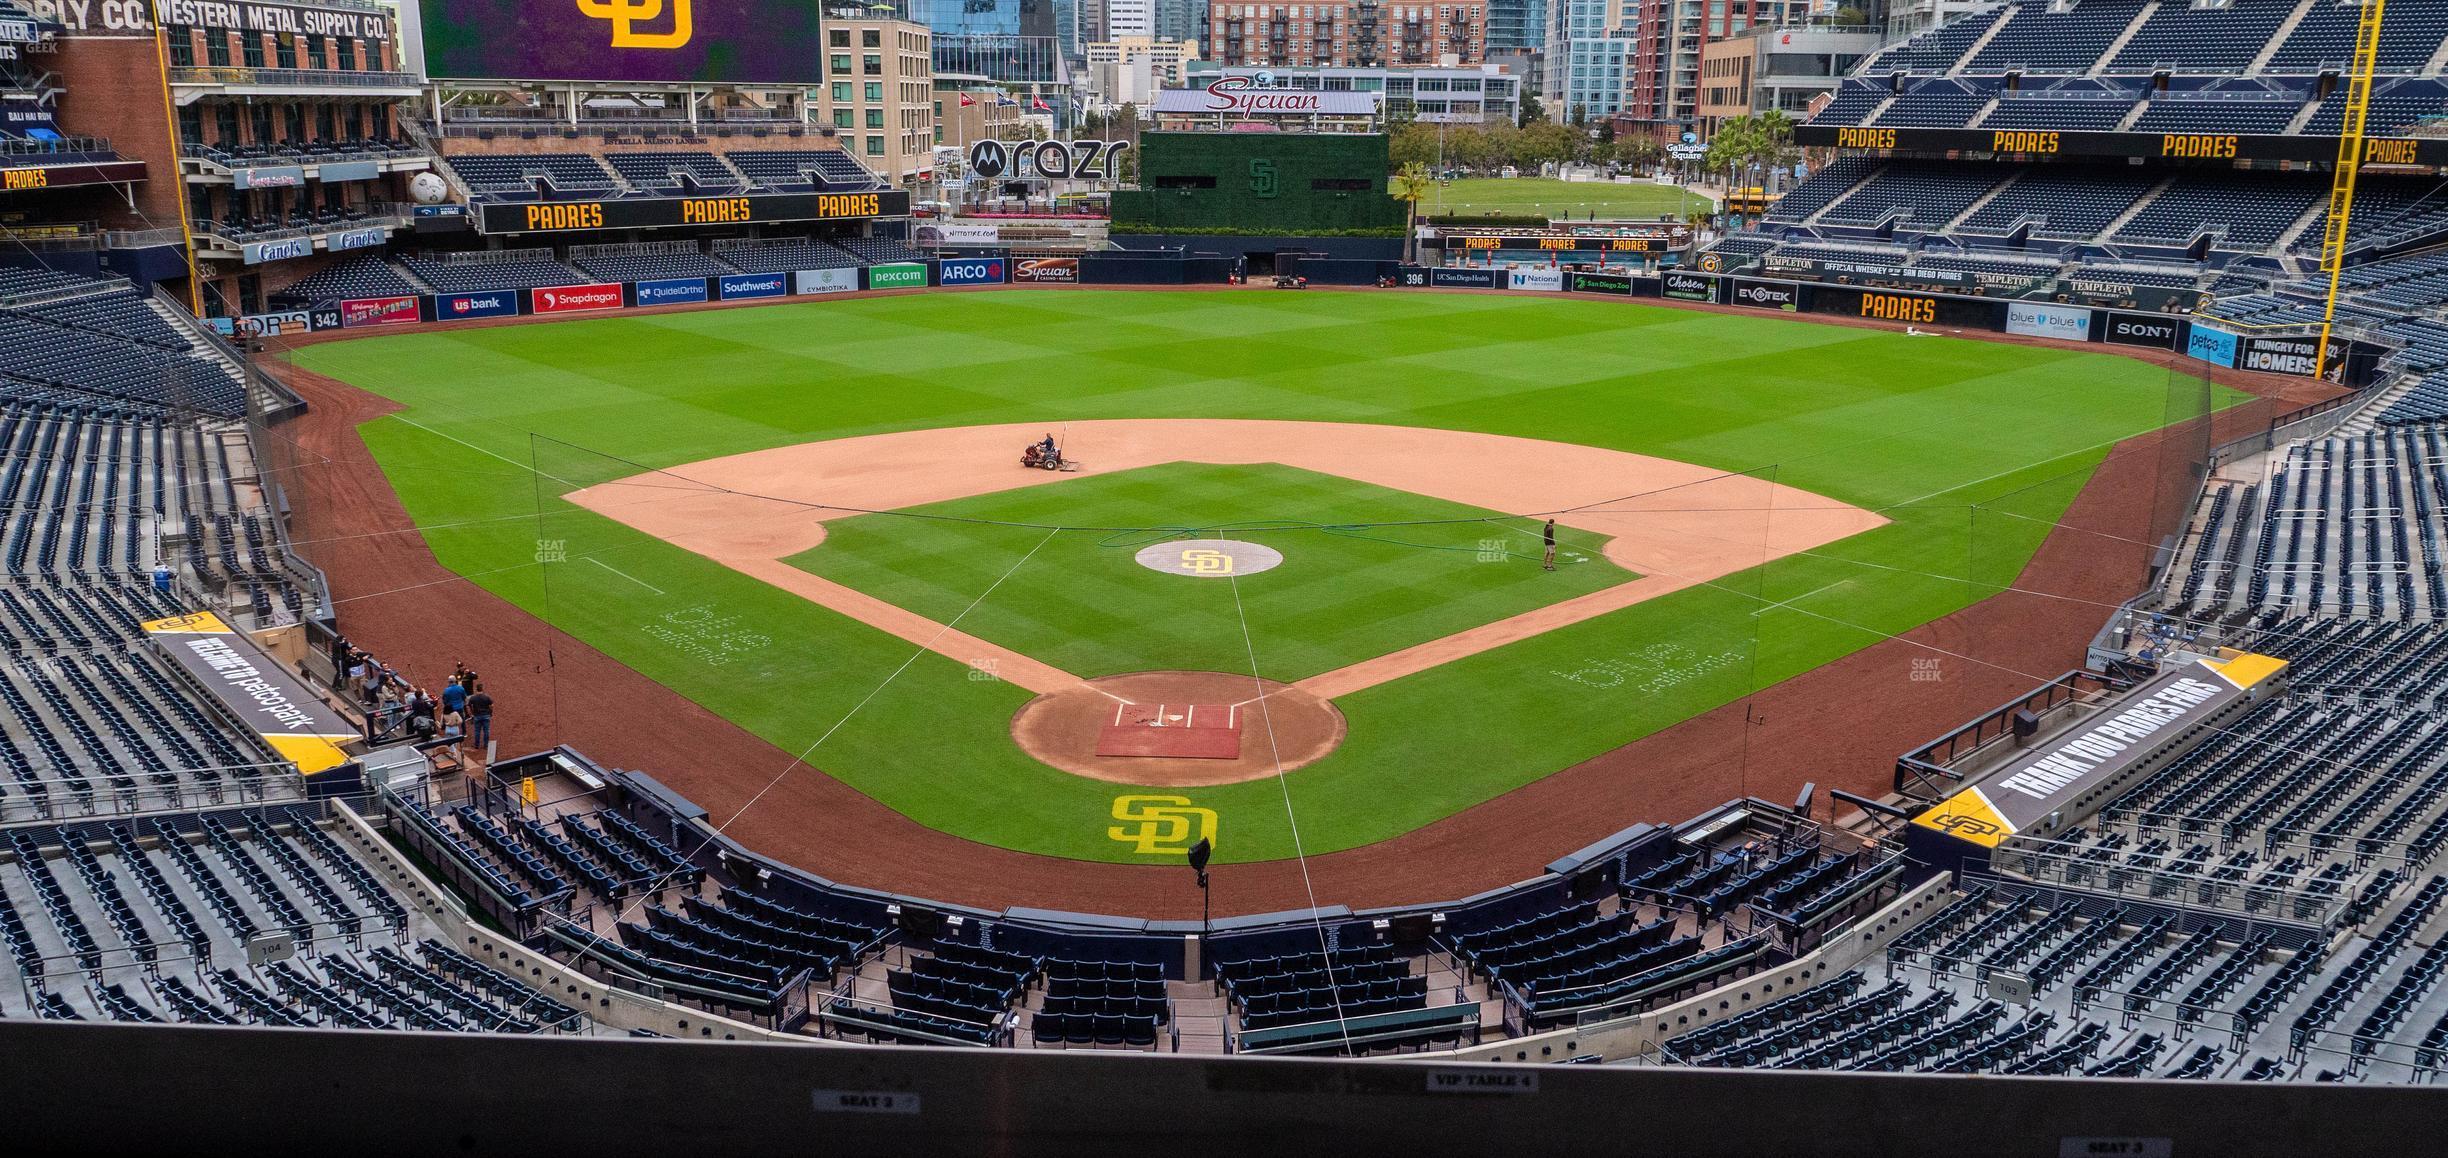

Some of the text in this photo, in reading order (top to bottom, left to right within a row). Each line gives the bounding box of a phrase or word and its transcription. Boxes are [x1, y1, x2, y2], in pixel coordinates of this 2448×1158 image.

[102, 0, 155, 30] CO.
[156, 0, 387, 39] WESTERN METAL SUPPLY CO.
[1206, 76, 1321, 120] Sycuan
[1838, 128, 1896, 148] PADRES
[1993, 131, 2059, 152] PADRES
[2162, 135, 2238, 158] PADRES
[2365, 139, 2417, 164] PADRES
[1012, 140, 1130, 180] razr
[1672, 152, 1702, 160] Square
[5, 169, 47, 189] PADRES
[682, 198, 750, 223] PADRES
[818, 194, 879, 216] PADRES
[527, 203, 603, 229] PADRES
[340, 230, 377, 249] Canel's
[1466, 238, 1501, 248] PADRES
[1541, 240, 1576, 249] PADRES
[1613, 241, 1648, 250] PADRES
[259, 240, 302, 261] Canel's
[1017, 260, 1071, 281] Sycuan
[1765, 257, 1812, 269] TEMPLETON
[943, 266, 987, 280] ARCO
[1407, 274, 1422, 285] 396
[1528, 274, 1559, 282] National
[1824, 263, 1854, 273] OFFICIAL
[1856, 265, 1886, 275] WHISKEY
[1903, 269, 1916, 277] SAN
[1917, 270, 1936, 279] DIEGO
[1937, 272, 1962, 281] PADRES
[724, 280, 775, 293] Southwest
[1600, 281, 1617, 289] Diego
[1667, 275, 1705, 290] Chosen
[1975, 274, 2032, 287] TEMPLETON
[654, 286, 704, 298] QuidelOrtho
[807, 285, 848, 293] CYMBIOTIKA
[1739, 287, 1789, 302] EVOTEK
[2071, 282, 2133, 295] TEMPLETON
[471, 298, 500, 309] bank
[559, 293, 617, 305] Snapdragon
[1861, 293, 1936, 323] PADRES
[316, 313, 338, 327] 342
[2010, 311, 2035, 323] blue
[2050, 315, 2075, 327] blue
[2117, 323, 2172, 338] SONY
[2254, 340, 2294, 354] HUNGRY
[2295, 343, 2315, 355] FOR
[2247, 352, 2317, 375] HOMERS
[1181, 549, 1233, 574] SD
[185, 637, 250, 671] WELCOME
[1998, 678, 2223, 799] THANK YOU PADRES FANS
[1108, 795, 1218, 854] SD
[262, 944, 281, 955] 104
[1999, 984, 2018, 996] 103
[1437, 1074, 1531, 1087] VIP TABLE 4
[840, 1095, 879, 1107] SEAT
[2088, 1142, 2130, 1153] SEAT
